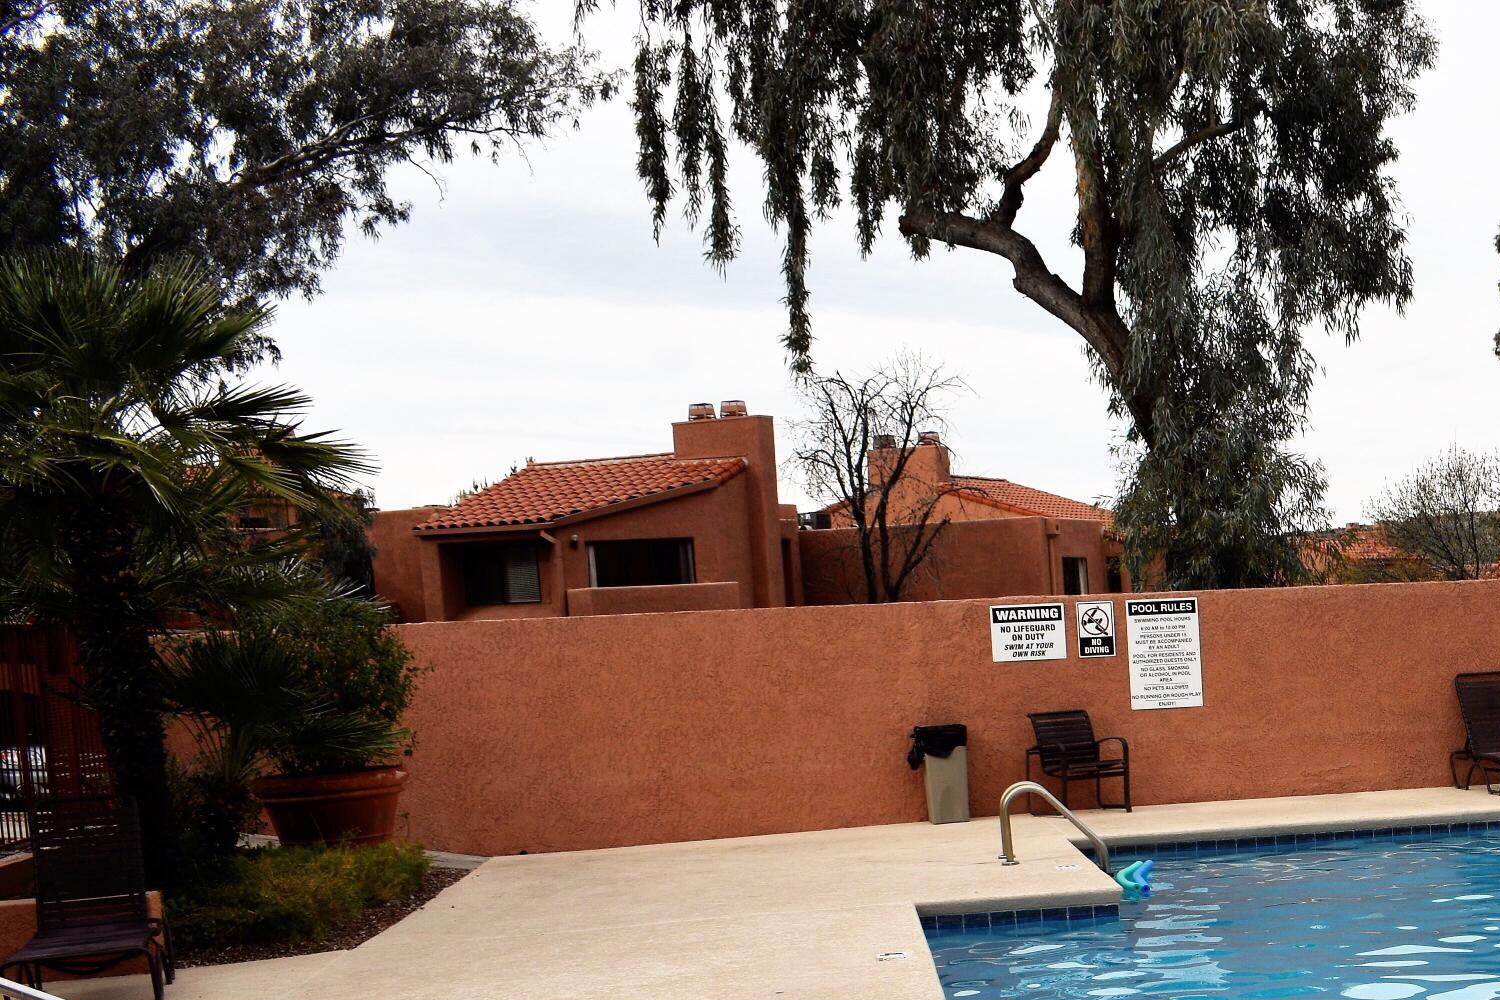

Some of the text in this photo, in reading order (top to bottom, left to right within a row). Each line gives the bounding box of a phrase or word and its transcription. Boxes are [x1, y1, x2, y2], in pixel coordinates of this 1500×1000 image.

[1131, 602, 1192, 613] POOL RULES
[996, 608, 1059, 620] WARNING
[1013, 624, 1056, 633] LIFEGUARD
[1084, 646, 1110, 654] DIVING
